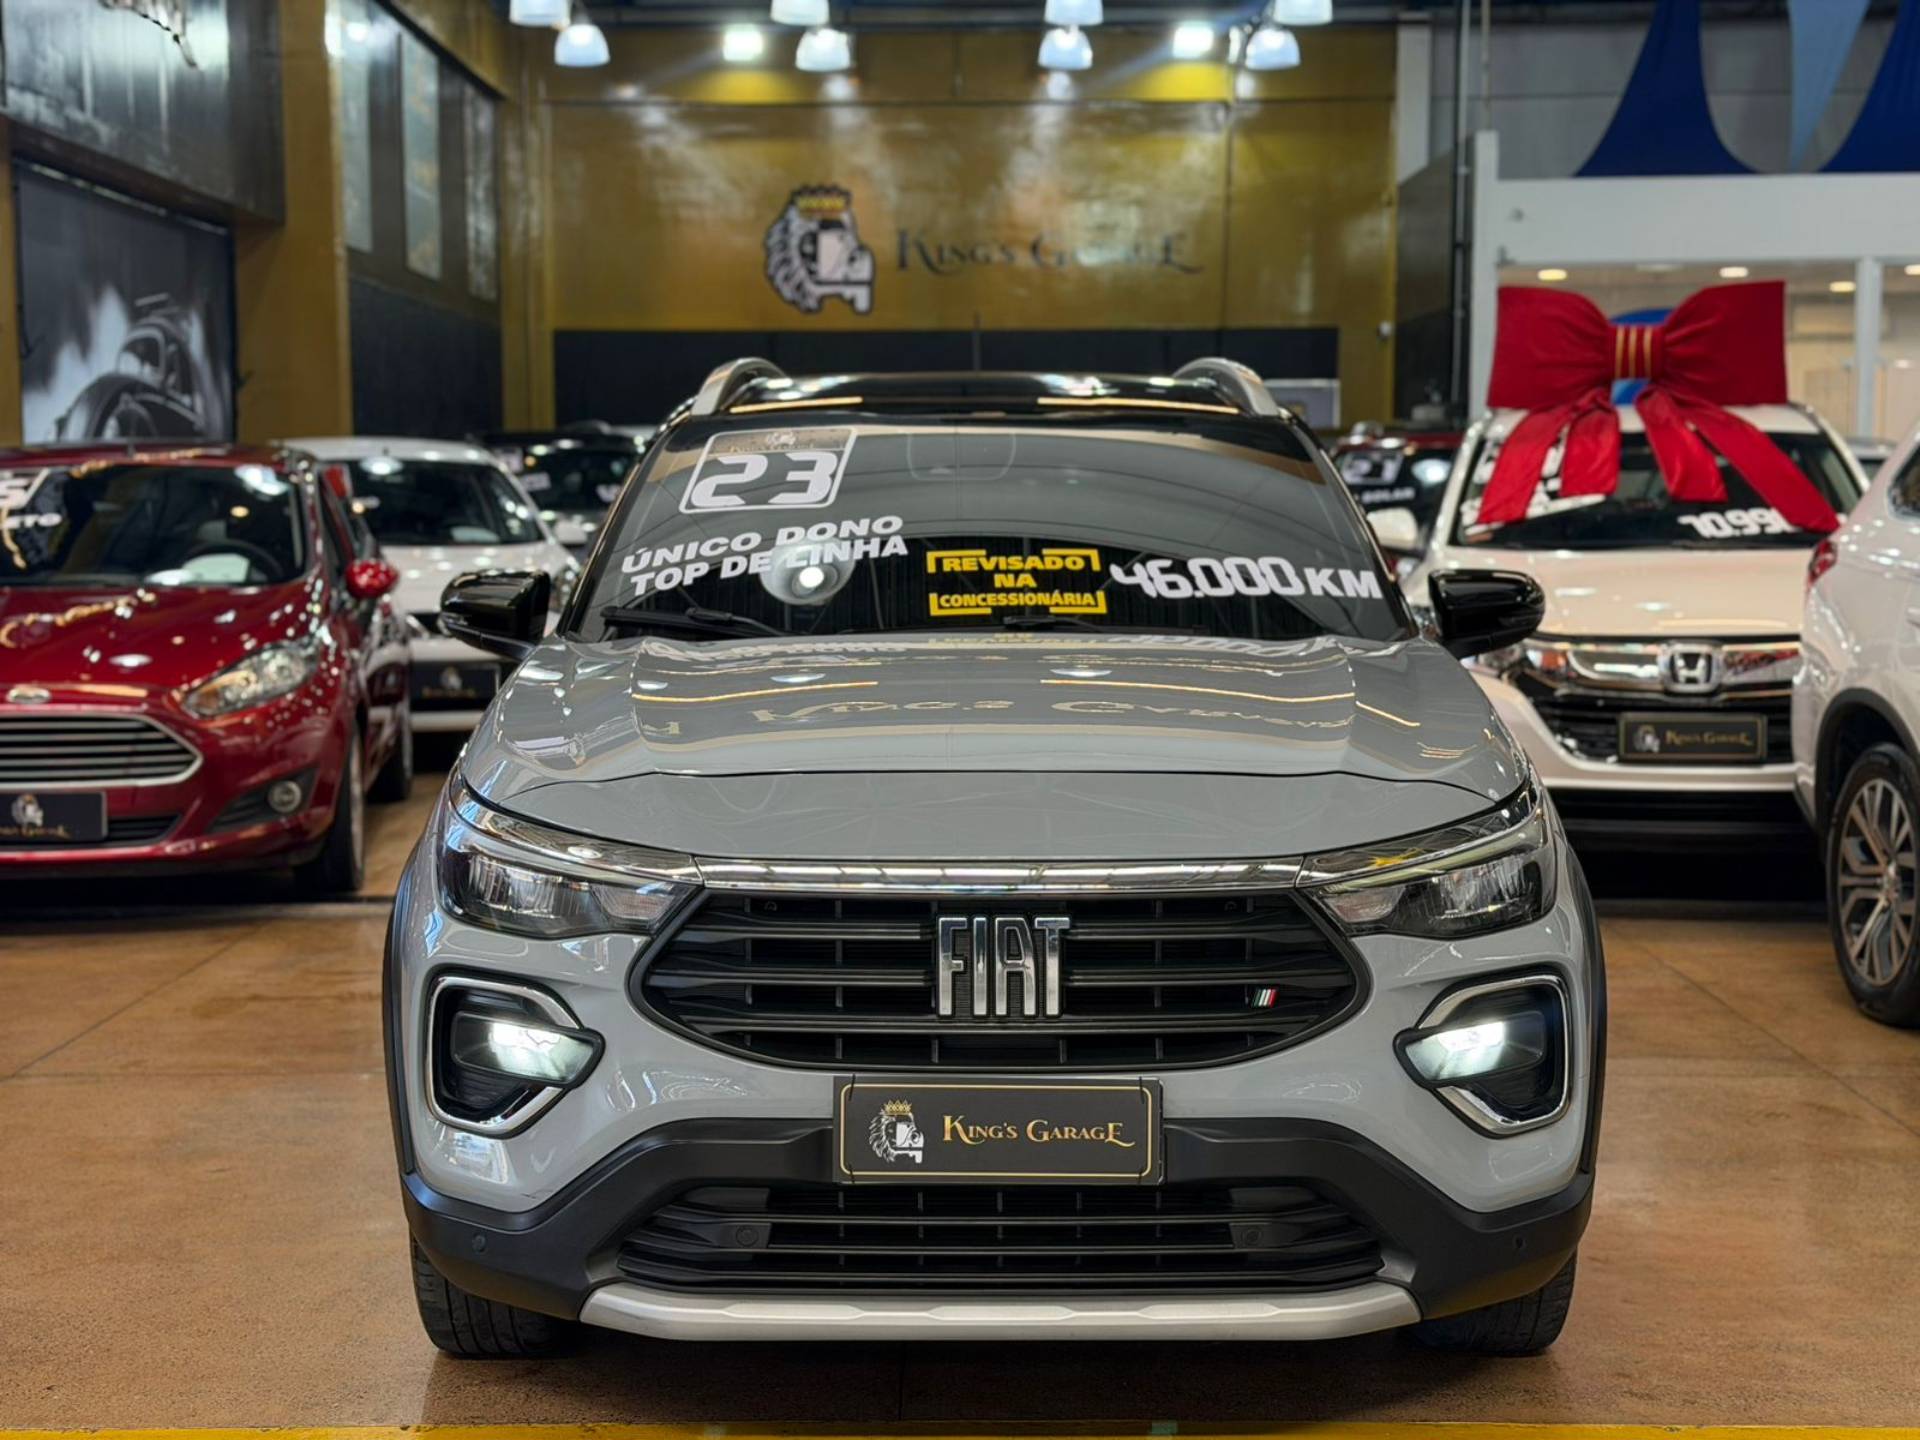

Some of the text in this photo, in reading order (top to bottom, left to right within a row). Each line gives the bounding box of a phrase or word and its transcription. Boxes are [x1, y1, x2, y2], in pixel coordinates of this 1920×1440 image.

[691, 451, 840, 508] 23
[621, 515, 905, 574] ÚNICO DONO
[630, 535, 909, 596] TOP DE LINHA
[943, 555, 1085, 572] REVISADO
[940, 589, 1096, 608] CONCESSIONÁRIA
[994, 573, 1037, 588] NA
[937, 916, 1071, 1017] FIAT
[943, 1115, 1136, 1148] KING'S GARAGE
